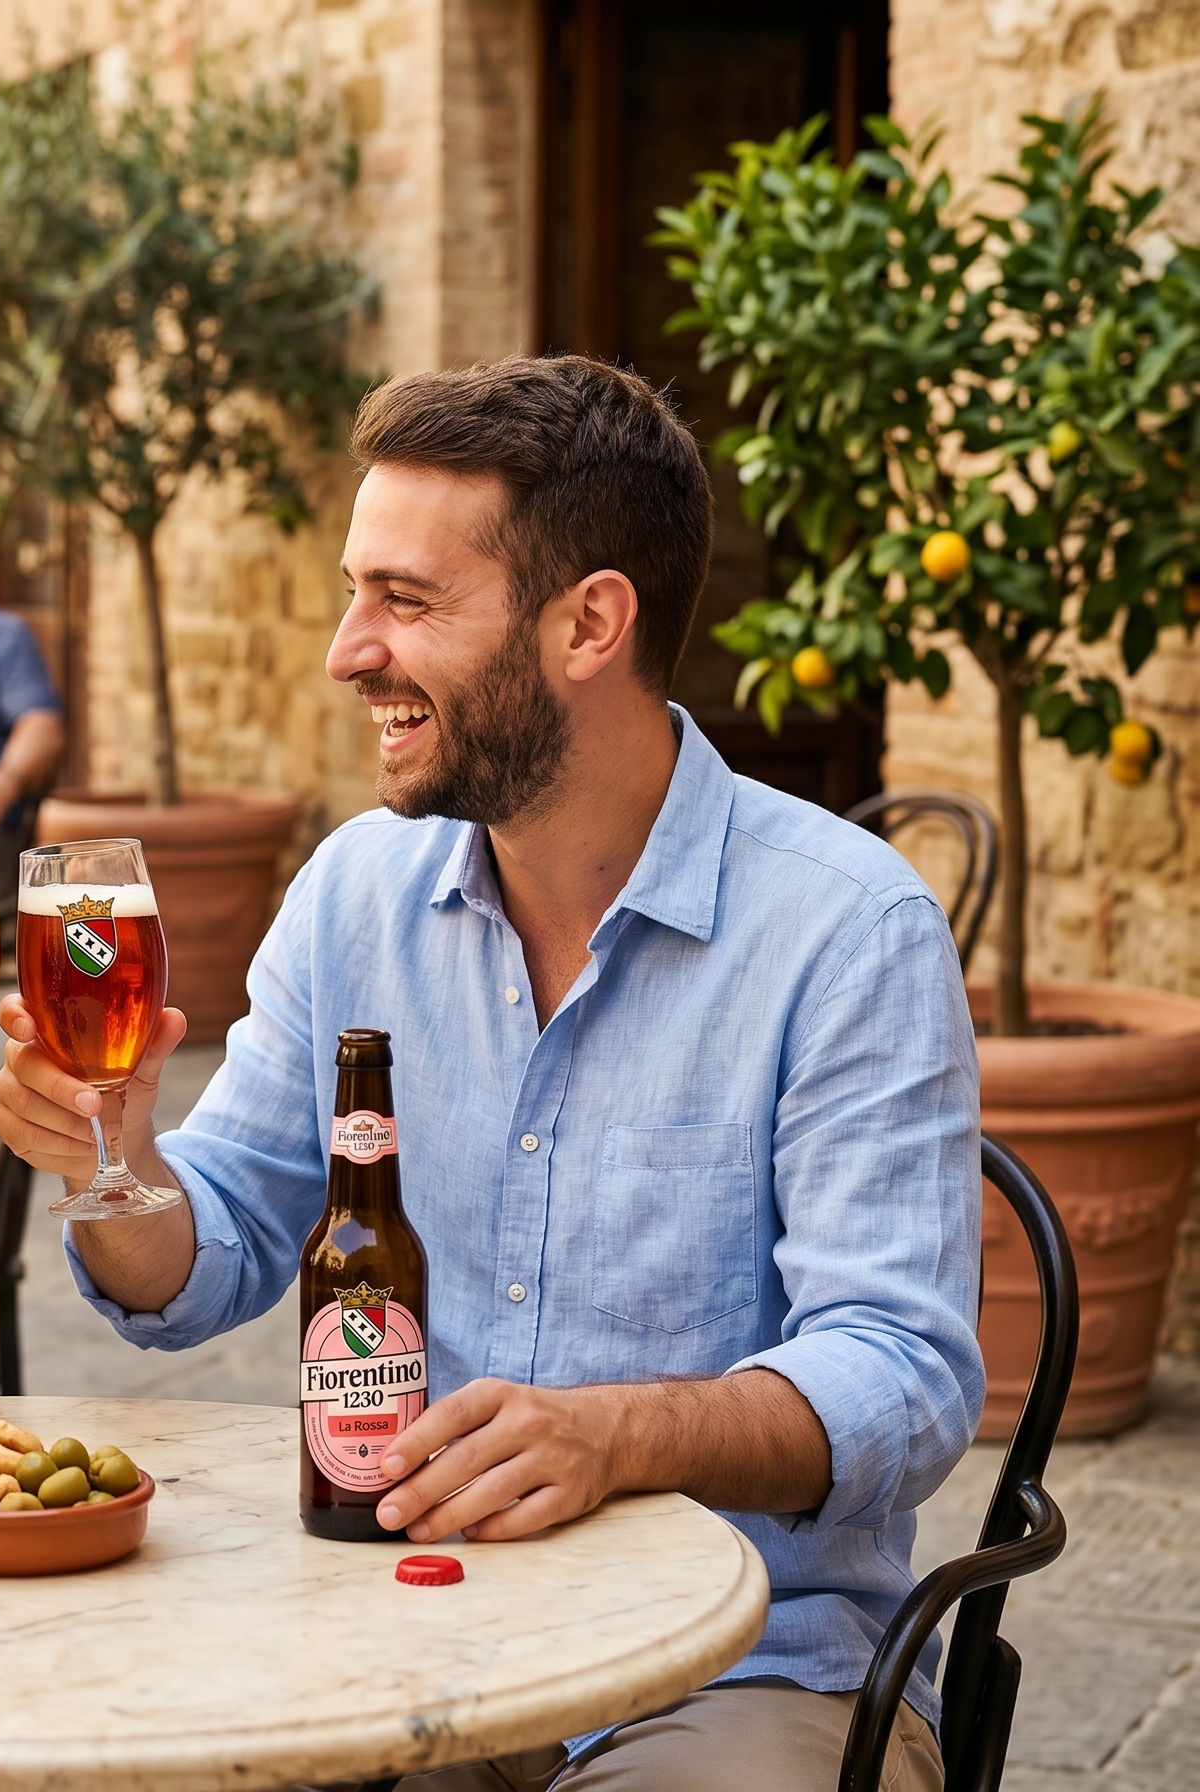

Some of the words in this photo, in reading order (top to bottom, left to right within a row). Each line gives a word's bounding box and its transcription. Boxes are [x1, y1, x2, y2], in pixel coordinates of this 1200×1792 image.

[343, 1390, 384, 1408] 1230
[339, 1421, 351, 1432] La
[354, 1420, 389, 1432] Rossa
